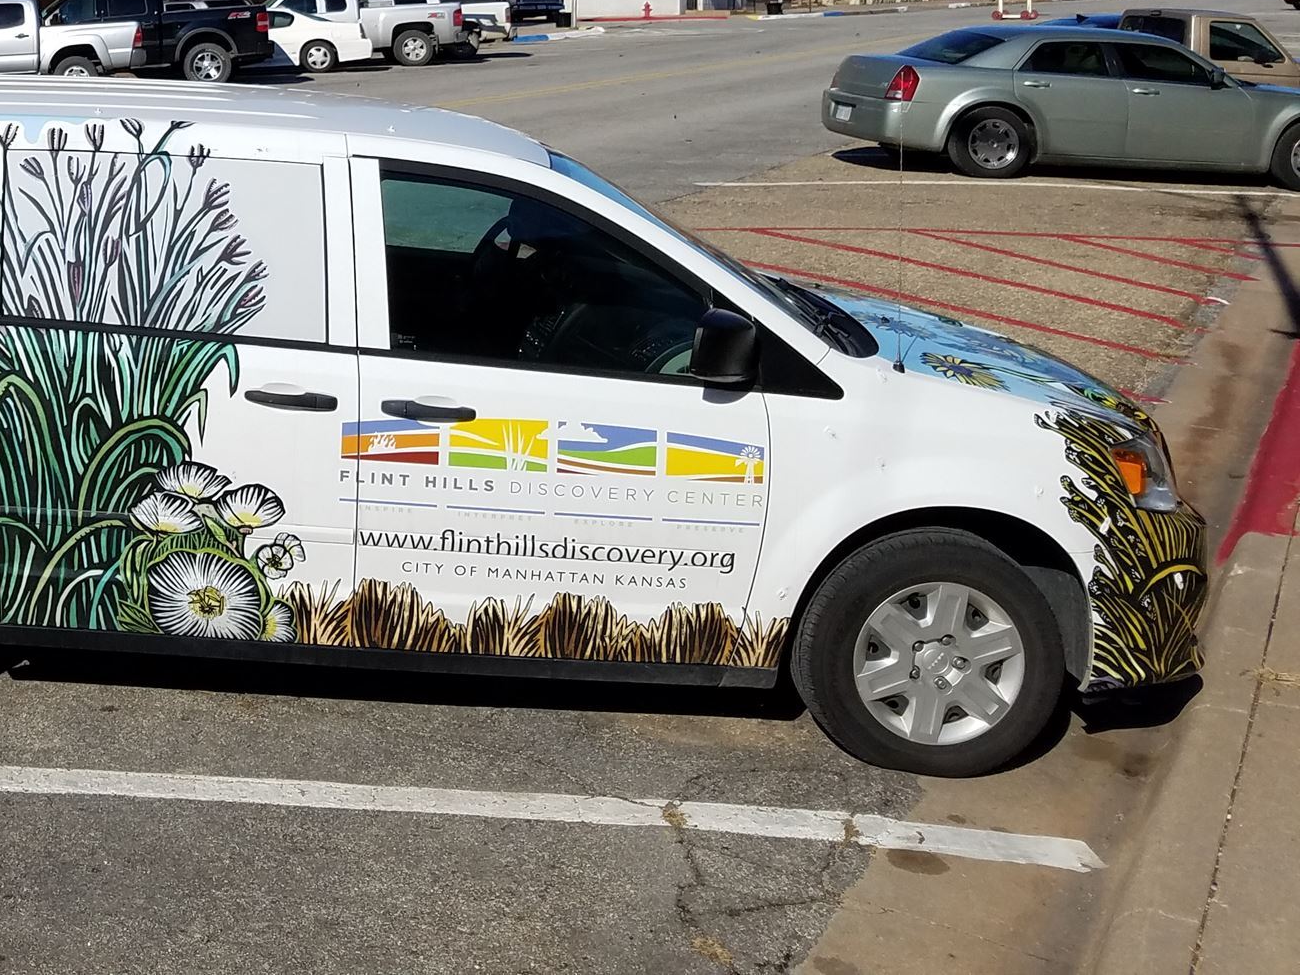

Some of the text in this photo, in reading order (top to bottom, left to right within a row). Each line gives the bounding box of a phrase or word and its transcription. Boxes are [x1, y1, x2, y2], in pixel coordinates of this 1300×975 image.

[339, 470, 764, 508] FLINT HILLS DISCOVERY CENTER
[573, 518, 634, 528] EXPLORE
[359, 529, 736, 574] www.flinthillsdiscovery.org
[401, 561, 688, 590] CITY OF MANHATTAN KANSAS
